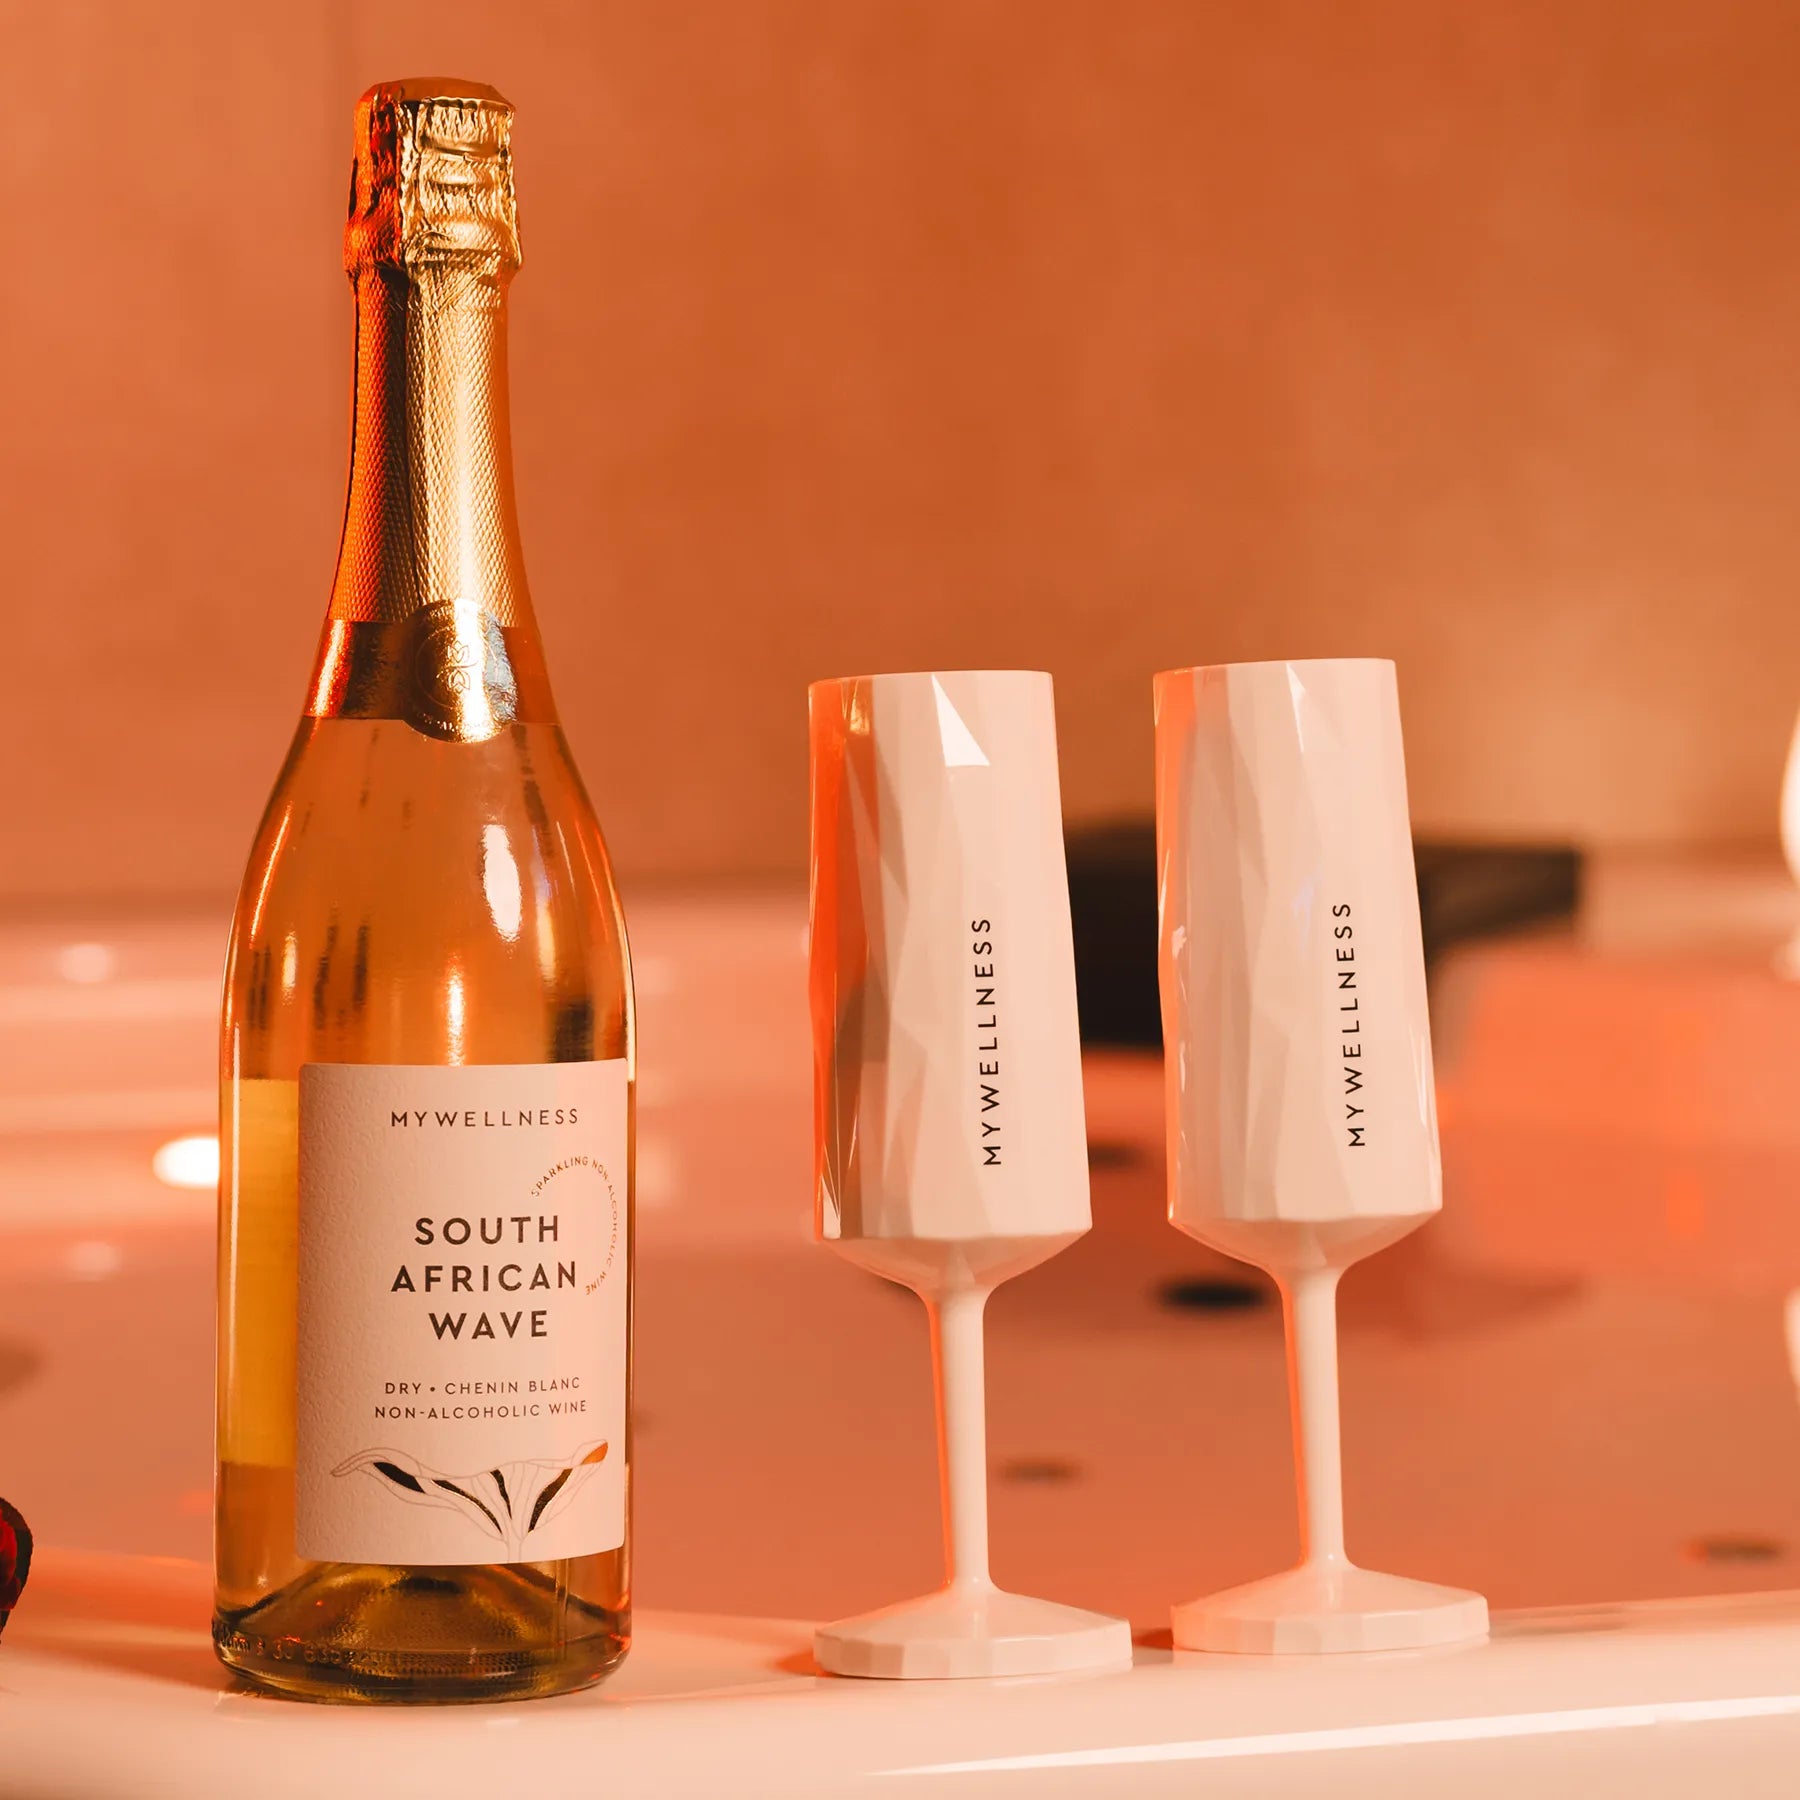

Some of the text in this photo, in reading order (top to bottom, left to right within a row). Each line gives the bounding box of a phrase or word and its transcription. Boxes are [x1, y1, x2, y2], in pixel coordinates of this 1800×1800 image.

[1332, 903, 1366, 1148] MYWELLNESS
[971, 918, 1002, 1166] MYWELLNESS
[390, 1108, 578, 1128] MYWELLNESS
[414, 1215, 559, 1245] SOUTH
[531, 1156, 589, 1197] SPARKLING
[585, 1271, 607, 1296] WINE
[391, 1261, 576, 1292] AFRICAN
[428, 1310, 548, 1340] WAVE
[385, 1377, 580, 1395] DRY CHENIN BLANC
[375, 1400, 587, 1419] NON-ALCOHOLIC WINE
